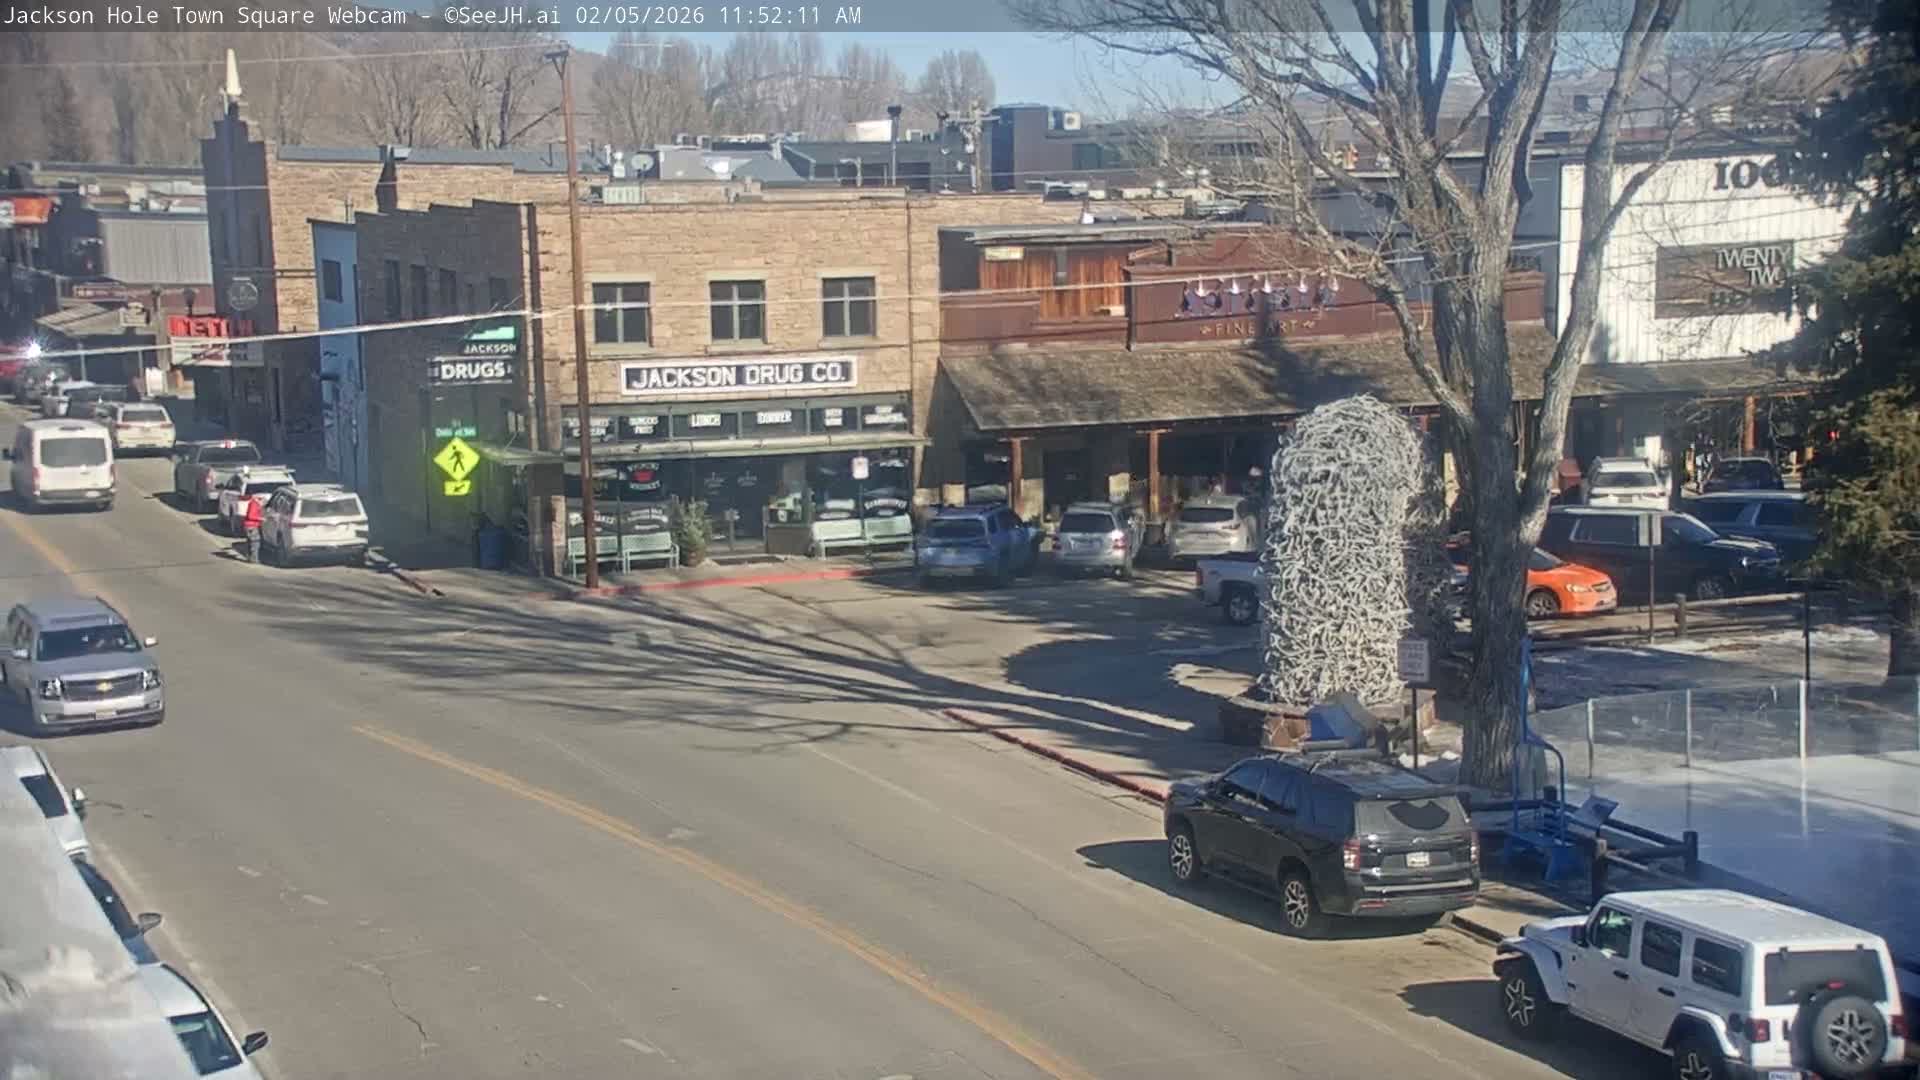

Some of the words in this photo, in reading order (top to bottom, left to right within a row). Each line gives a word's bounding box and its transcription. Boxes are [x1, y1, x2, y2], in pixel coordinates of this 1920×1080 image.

[1715, 246, 1791, 269] TWENTY
[464, 343, 517, 354] JACKSON
[441, 361, 505, 380] DRUGS
[632, 365, 737, 389] JACKSON
[745, 363, 804, 385] DRUG
[811, 361, 847, 382] CO.
